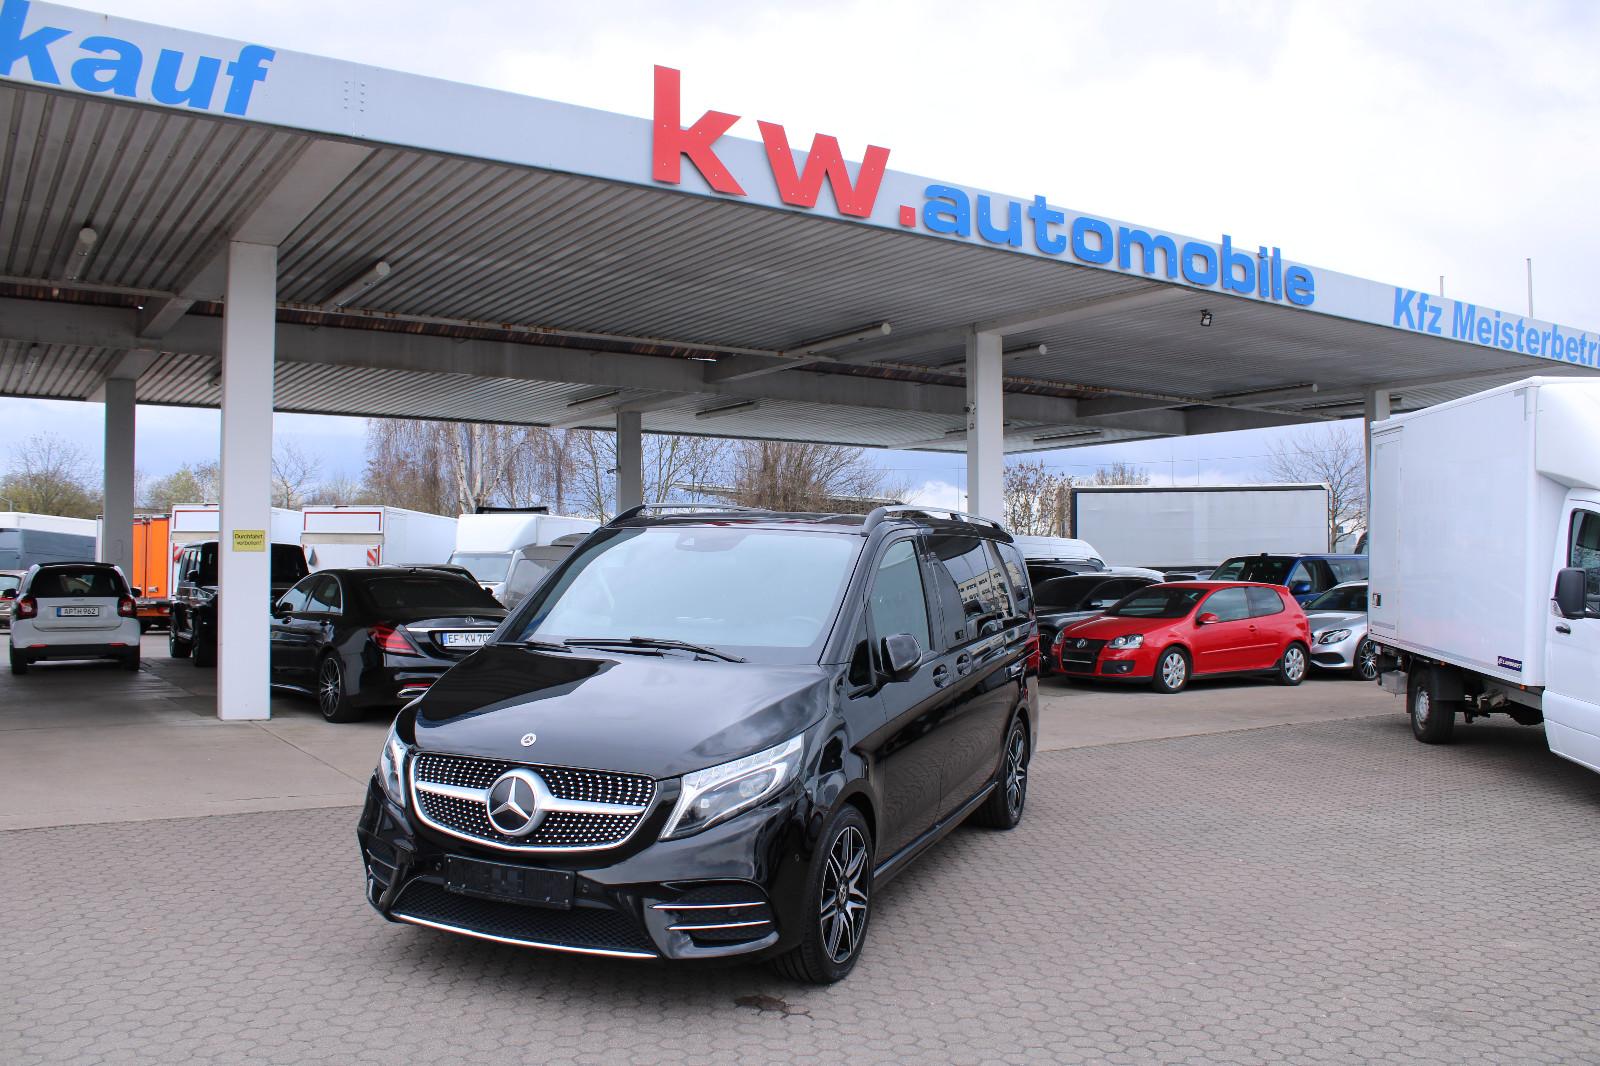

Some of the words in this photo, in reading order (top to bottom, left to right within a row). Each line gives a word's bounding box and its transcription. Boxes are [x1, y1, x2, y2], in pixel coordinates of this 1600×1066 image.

[0, 0, 276, 116] kauf
[1393, 287, 1442, 335] Kfz
[447, 634, 460, 644] EF
[464, 634, 476, 644] KW
